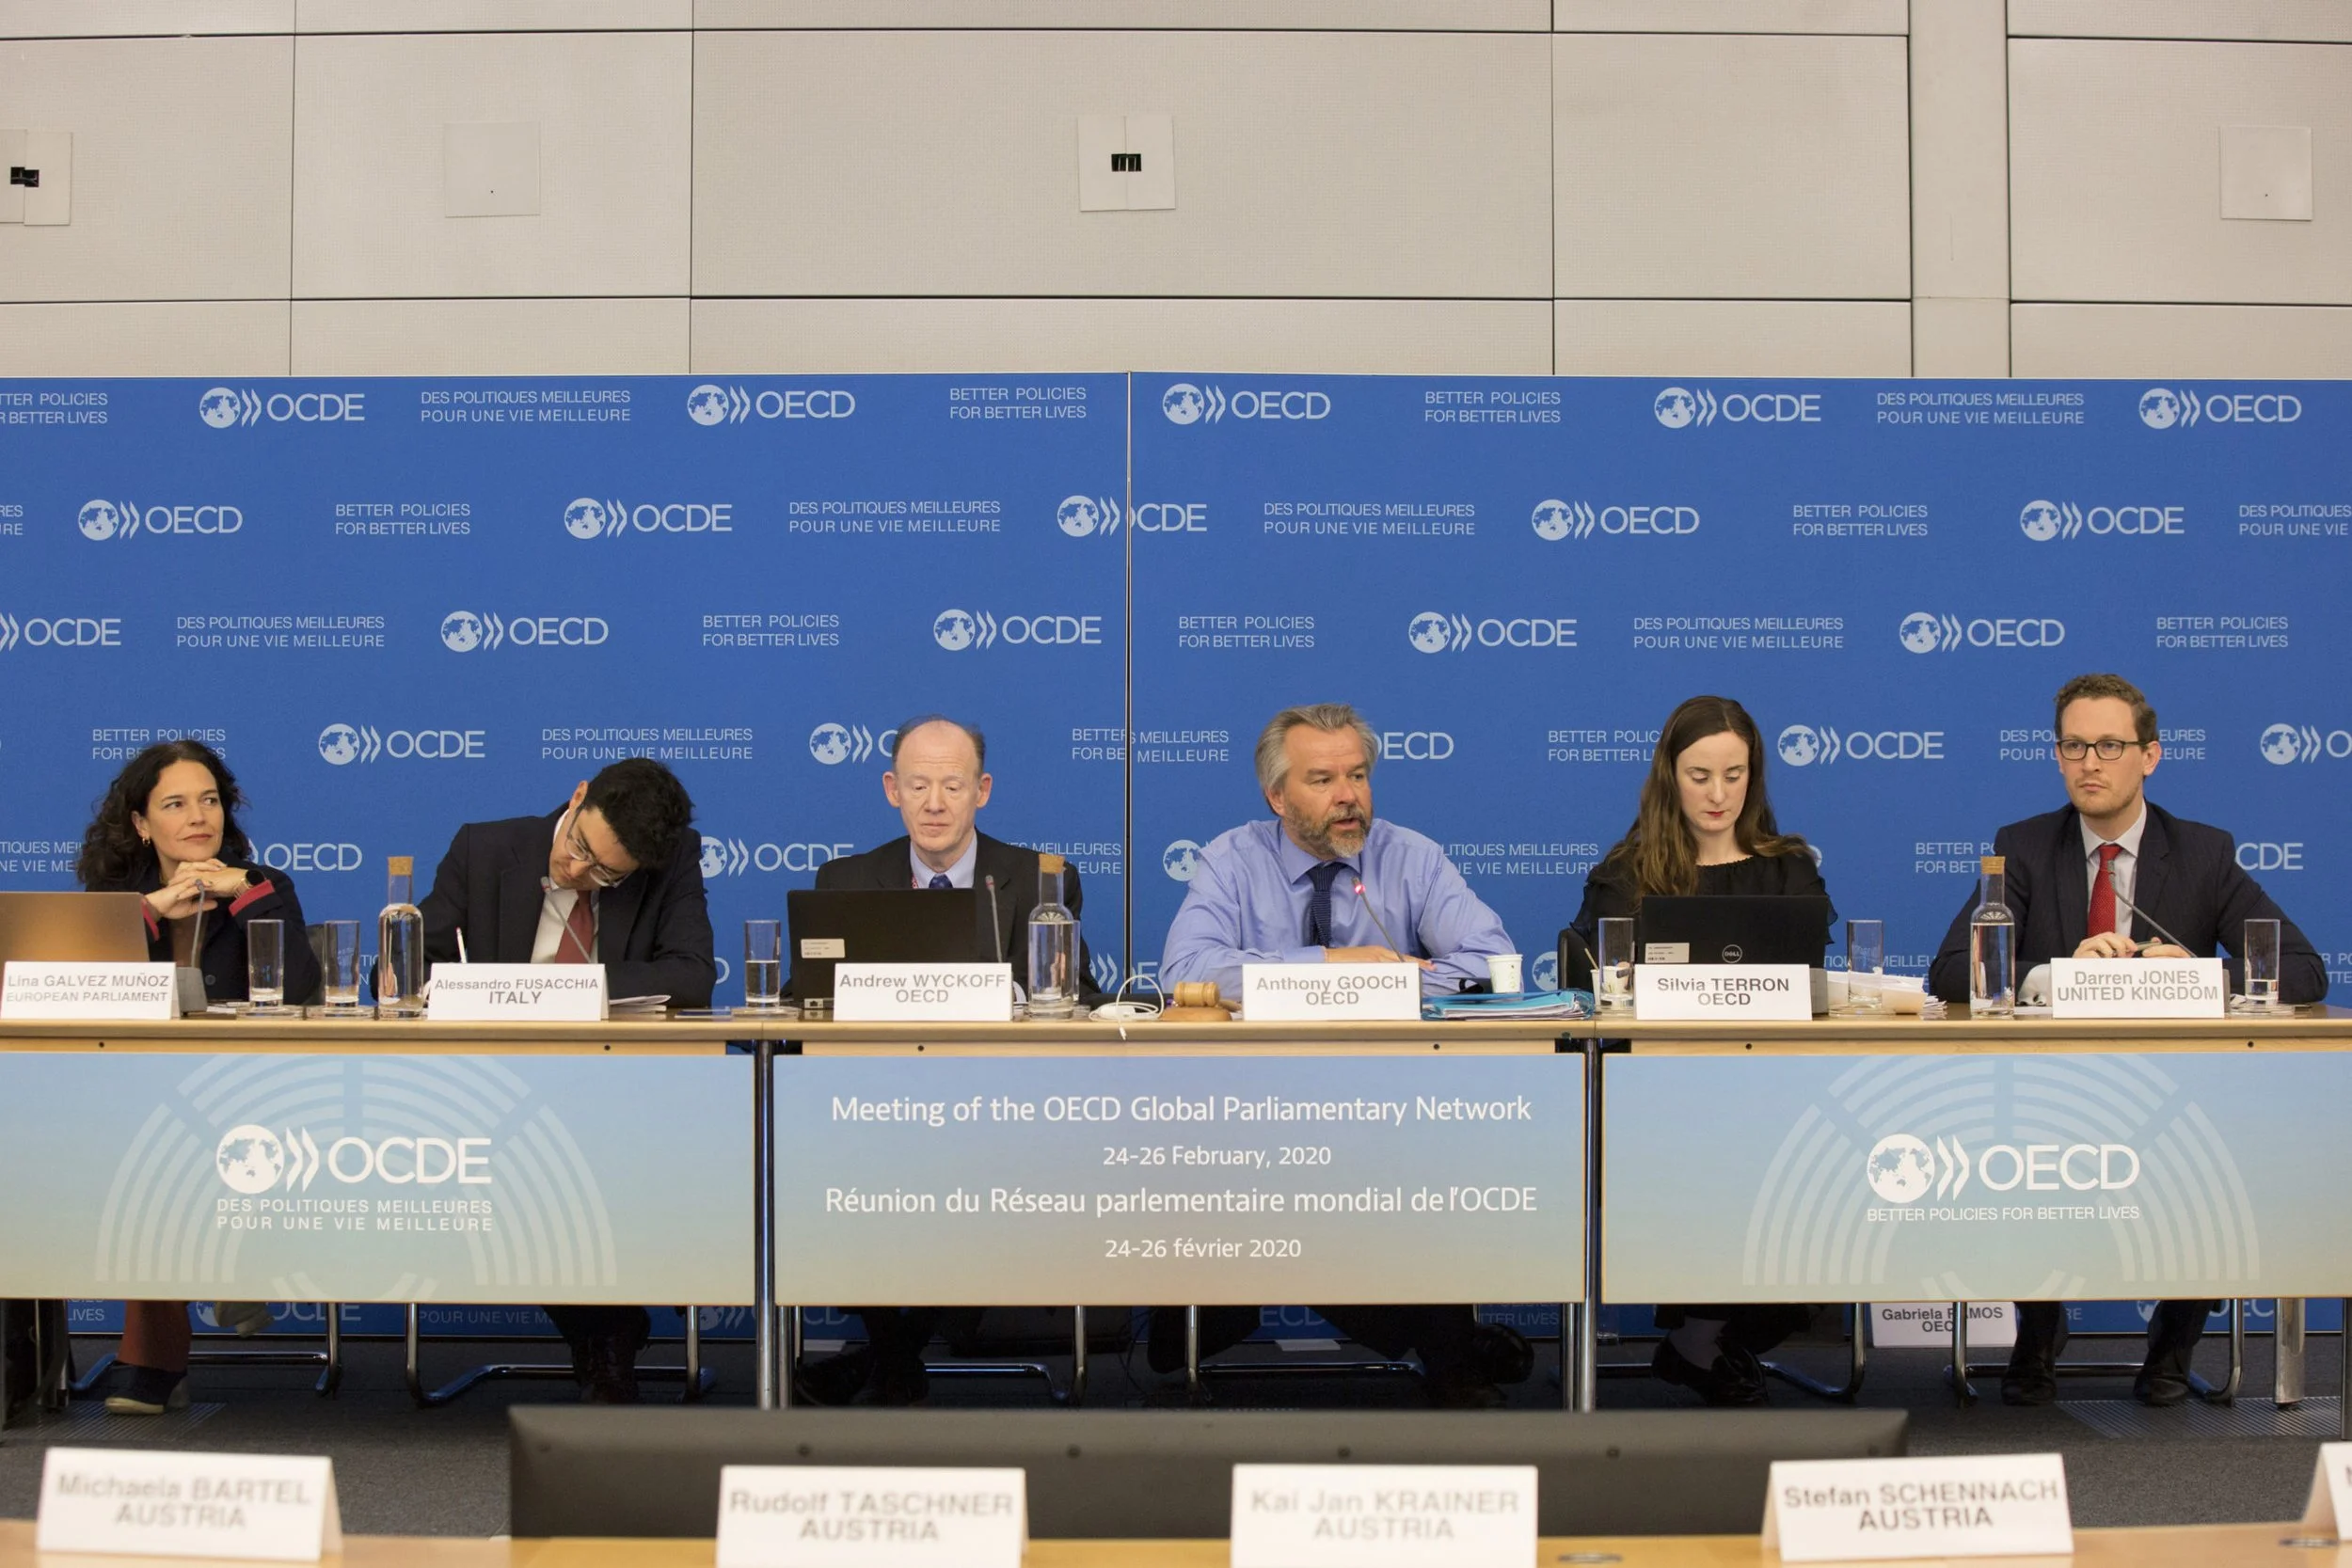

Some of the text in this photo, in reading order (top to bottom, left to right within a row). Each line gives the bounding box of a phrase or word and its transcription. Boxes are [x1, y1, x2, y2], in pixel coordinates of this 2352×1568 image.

[421, 389, 631, 404] DES POLITIQUES MEILLEURES
[949, 387, 1087, 401] BETTER POLICIES
[266, 392, 366, 422] OCDE
[755, 389, 856, 419] OECD
[949, 404, 1088, 420] FOR BETTER LIVES
[1231, 390, 1331, 420] OECD
[1722, 393, 1821, 422] OCDE
[2205, 394, 2302, 423] OECD
[421, 408, 630, 422] POUR UNE VIE MEILLEURE
[789, 499, 1001, 515] DES POLITIQUES MEILLEURES
[1792, 503, 1929, 518] BETTER POLICIES
[144, 505, 244, 534] OECD
[632, 503, 733, 532] OCDE
[1599, 505, 1701, 535] OECD
[2087, 506, 2185, 535] OCDE
[789, 519, 1001, 533] POUR UNE VIE MEILLEURE
[1793, 522, 1929, 537] FOR BETTER LIVES
[703, 614, 840, 628] BETTER POLICIES
[1633, 616, 1844, 630] DES POLITIQUES MEILLEURES
[2156, 616, 2289, 630] BETTER POLICIES
[24, 617, 121, 646] OCDE
[508, 616, 610, 646] OECD
[1001, 615, 1103, 644] OCDE
[1476, 618, 1578, 647] OCDE
[1966, 618, 2066, 647] OECD
[703, 632, 840, 647] FOR BETTER LIVES
[1633, 635, 1845, 649] POUR UNE VIE MEILLEURE
[2156, 634, 2289, 648] FOR BETTER LIVES
[92, 729, 226, 742] BETTER POLICIES
[542, 727, 754, 742] DES POLITIQUES MEILLEURES
[1139, 730, 1230, 744] MEILLEURES
[1548, 730, 1607, 743] BETTER
[1999, 729, 2029, 742] DES
[386, 729, 485, 759] OCDE
[1845, 731, 1945, 760] OCDE
[92, 747, 123, 760] FOR
[542, 746, 754, 760] POUR UNE VIE MEILLEURE
[1136, 749, 1229, 764] MEILLEURE
[1548, 748, 1640, 762] FOR BETTER
[1999, 747, 2046, 761] POUR
[1508, 843, 1599, 857] MEILLEURES
[1915, 842, 1974, 855] BETTER
[263, 842, 363, 872] OECD
[1476, 862, 1502, 875] VIE
[1915, 860, 1947, 874] FOR
[8, 972, 170, 988] Lina GALVEZ MUÑOZ
[434, 977, 599, 990] Alessandro FUSACCHIA
[838, 974, 1006, 989] Andrew WYCKOFF
[1256, 974, 1407, 991] Anthony GOOCH
[1657, 977, 1789, 992] Silvia TERRON
[2074, 970, 2201, 986] Darren JONES
[6, 990, 168, 1003] EUROPEAN PARLIAMENT
[488, 990, 542, 1005] ITALY
[895, 989, 949, 1004] OECD
[1305, 990, 1359, 1006] OECD
[1697, 992, 1752, 1006] OECD
[2057, 985, 2218, 1002] UNITED KINGDOM
[833, 1095, 1532, 1128] Meeting of the OECD Global Parliamentary Network
[327, 1136, 492, 1184] OCDE
[1103, 1145, 1331, 1170] 24-26 February, 2020
[1979, 1143, 2140, 1191] OECD
[217, 1197, 492, 1214] DES POLITIQUES MEILLEURES
[826, 1186, 1537, 1218] Réunion du Réseau parlementaire mondial de l'OCDE
[1867, 1205, 2139, 1222] BETTER POLICIES FOR BETTER LIVES
[216, 1215, 493, 1232] POUR UNE VIE MEILLEURE
[1105, 1237, 1302, 1258] 24-26 février 2020
[1881, 1307, 1944, 1323] Gabriela
[1921, 1320, 1954, 1334] OEC
[56, 1472, 311, 1506] Michaela BARTEL
[1784, 1481, 2058, 1509] Stefan SCHENNACH
[728, 1489, 1013, 1517] Rudolf TASCHNER
[1250, 1489, 1518, 1514] Kai Jan KRAINER
[114, 1501, 246, 1528] AUSTRIA
[1858, 1507, 1994, 1531] AUSTRIA
[799, 1517, 939, 1541] AUSTRIA
[1313, 1515, 1455, 1541] AUSTRIA
